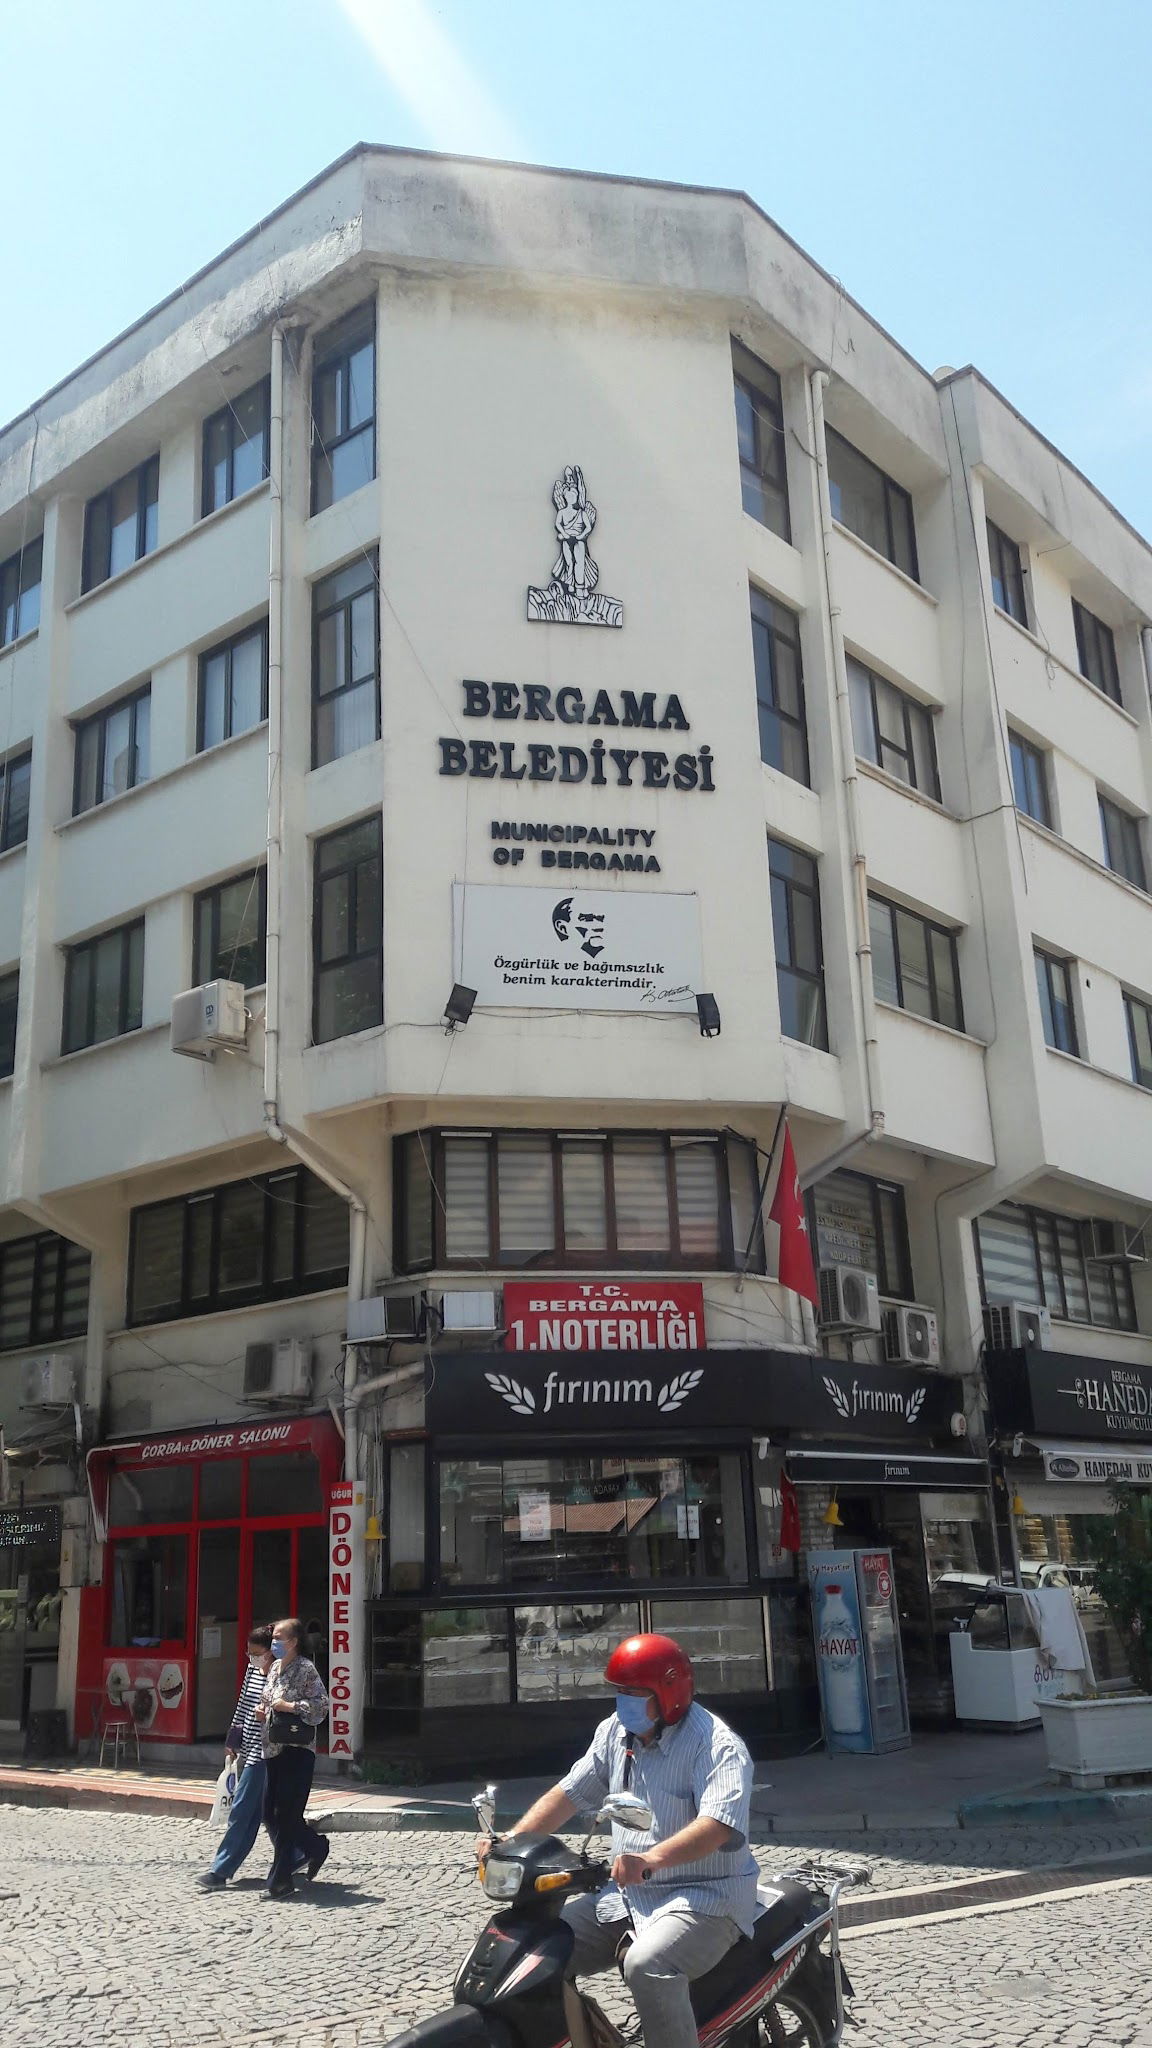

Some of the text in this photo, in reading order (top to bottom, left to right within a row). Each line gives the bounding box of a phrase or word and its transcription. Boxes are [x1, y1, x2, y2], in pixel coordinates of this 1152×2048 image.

[462, 680, 690, 731] BERGAMA
[438, 737, 716, 792] BELEDİYESİ
[491, 821, 656, 847] MUNICIPALITY
[492, 847, 661, 873] OF BERGAMA
[493, 956, 665, 974] Özgürlük ve bağımsızlık
[503, 974, 657, 989] benim karakterimdir.
[579, 1285, 629, 1297] T.C.
[528, 1300, 679, 1312] BERGAMA
[510, 1312, 699, 1351] 1.NOTERLİĞİ
[1111, 1370, 1142, 1385] BERGAMA
[543, 1371, 653, 1413] fırınım
[852, 1380, 904, 1417] fırınım
[142, 1441, 182, 1459] ÇORBA
[190, 1434, 234, 1451] DÖNER
[238, 1425, 291, 1445] SALONU
[1084, 1461, 1133, 1479] HANEDAN
[331, 1488, 352, 1500] UĞUR
[864, 1558, 884, 1570] HAYAT
[331, 1512, 352, 1754] DÖNER ÇORBA
[820, 1639, 858, 1656] HAYAT
[763, 1943, 807, 2005] SALCANO
